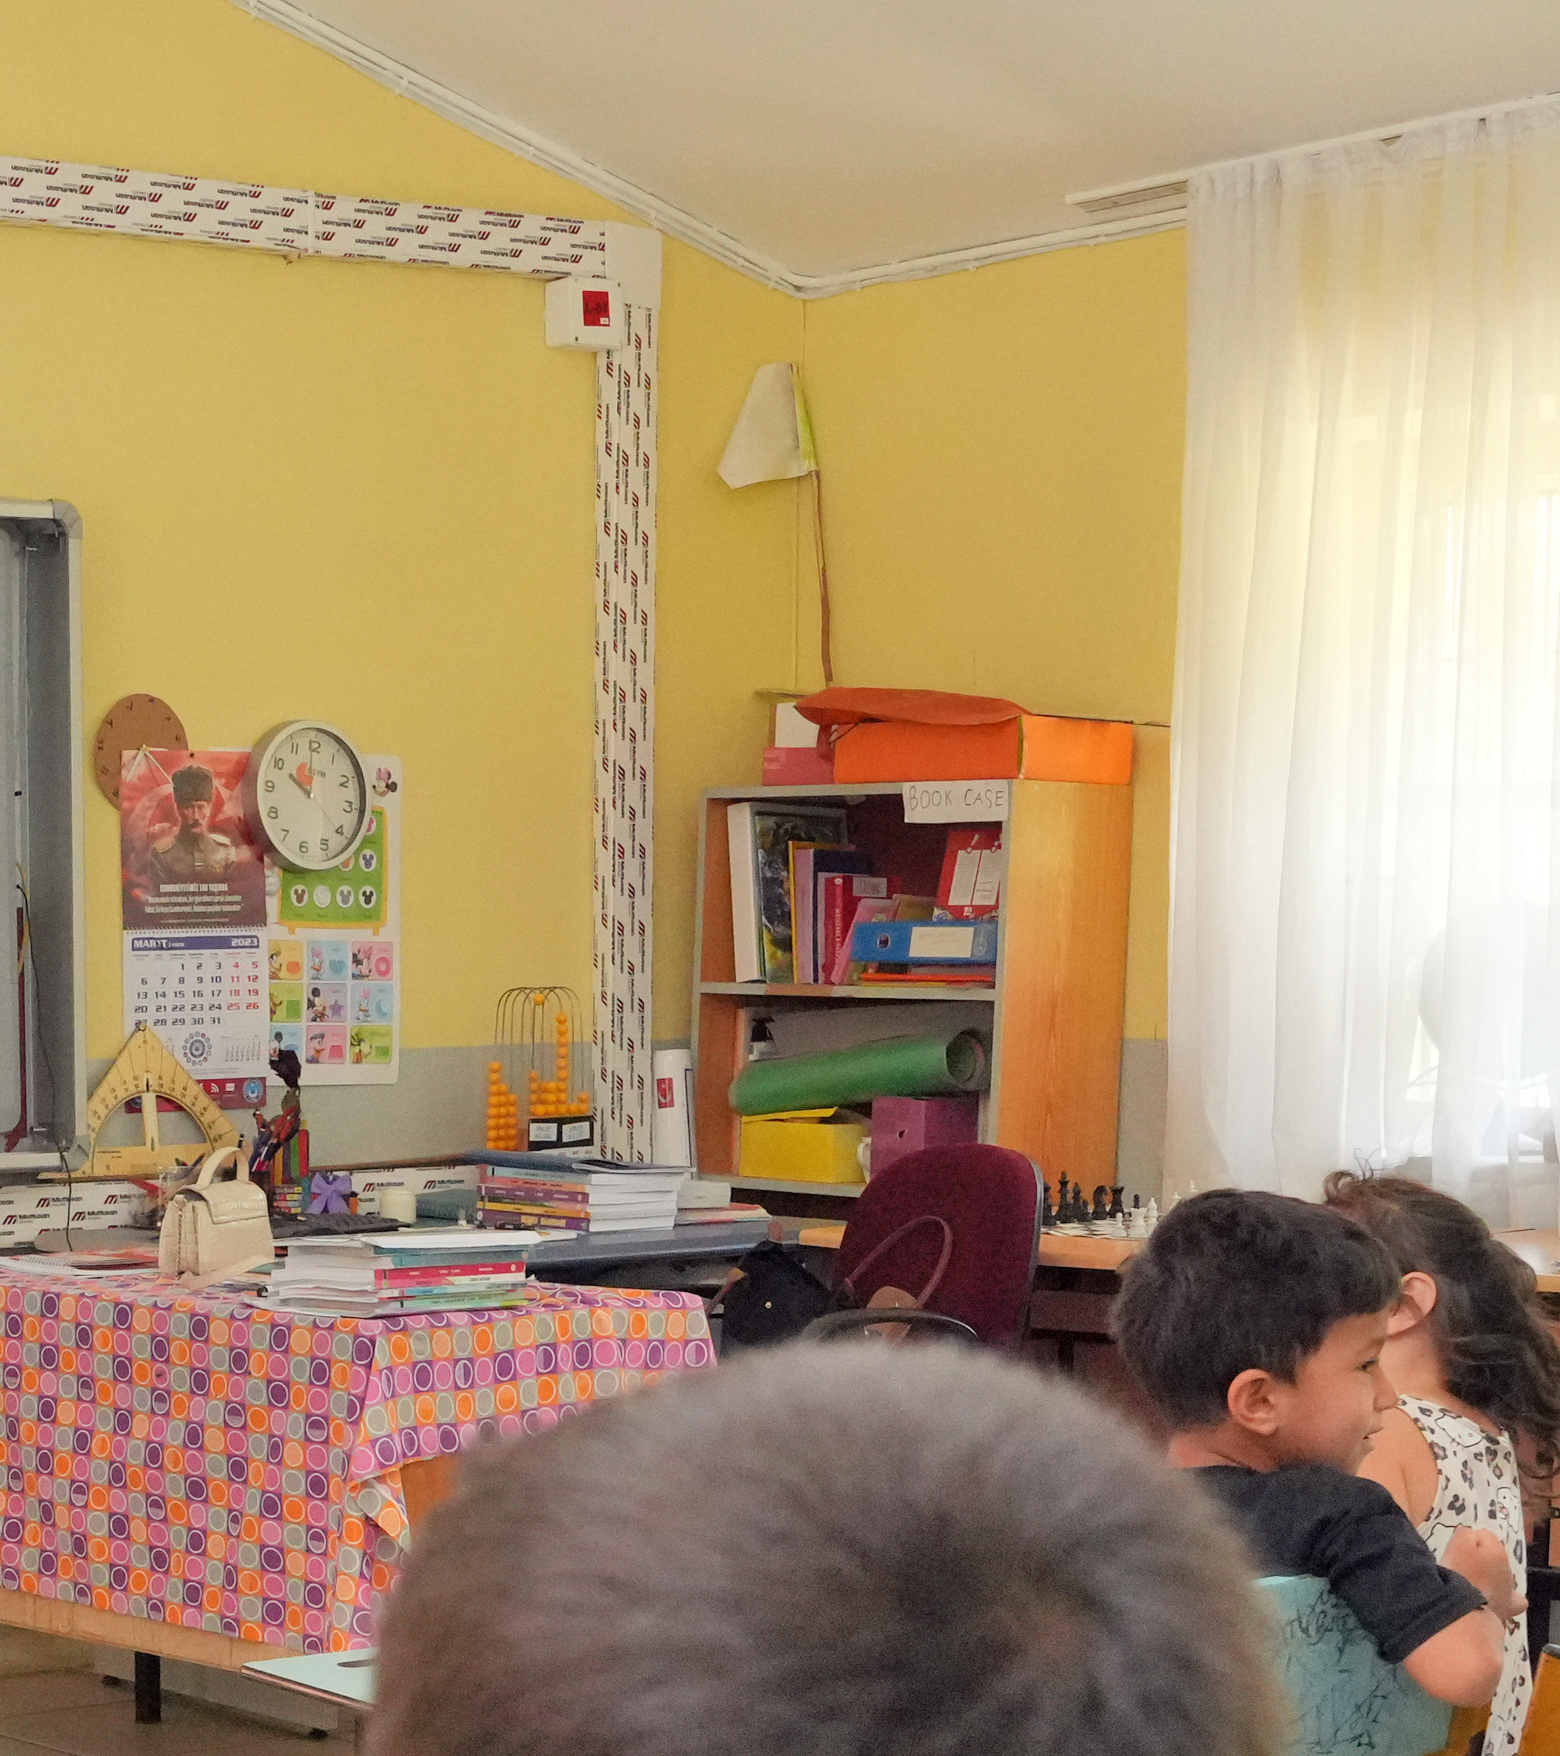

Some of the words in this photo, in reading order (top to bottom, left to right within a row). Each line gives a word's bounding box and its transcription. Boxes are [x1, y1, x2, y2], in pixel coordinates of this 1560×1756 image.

[291, 742, 299, 755] 11
[309, 740, 321, 754] 12
[274, 757, 284, 770] 10
[331, 753, 335, 765] 1
[264, 780, 275, 793] 9
[339, 775, 350, 788] 2
[909, 786, 952, 811] BOOK
[964, 788, 1005, 809] CASE
[267, 806, 279, 819] 8
[343, 800, 353, 814] 3
[281, 829, 290, 842] 7
[335, 825, 344, 836] 4
[299, 841, 309, 854] 6
[319, 839, 329, 851] 5
[231, 938, 257, 946] 2023
[160, 977, 166, 985] 7
[179, 976, 185, 984] 8
